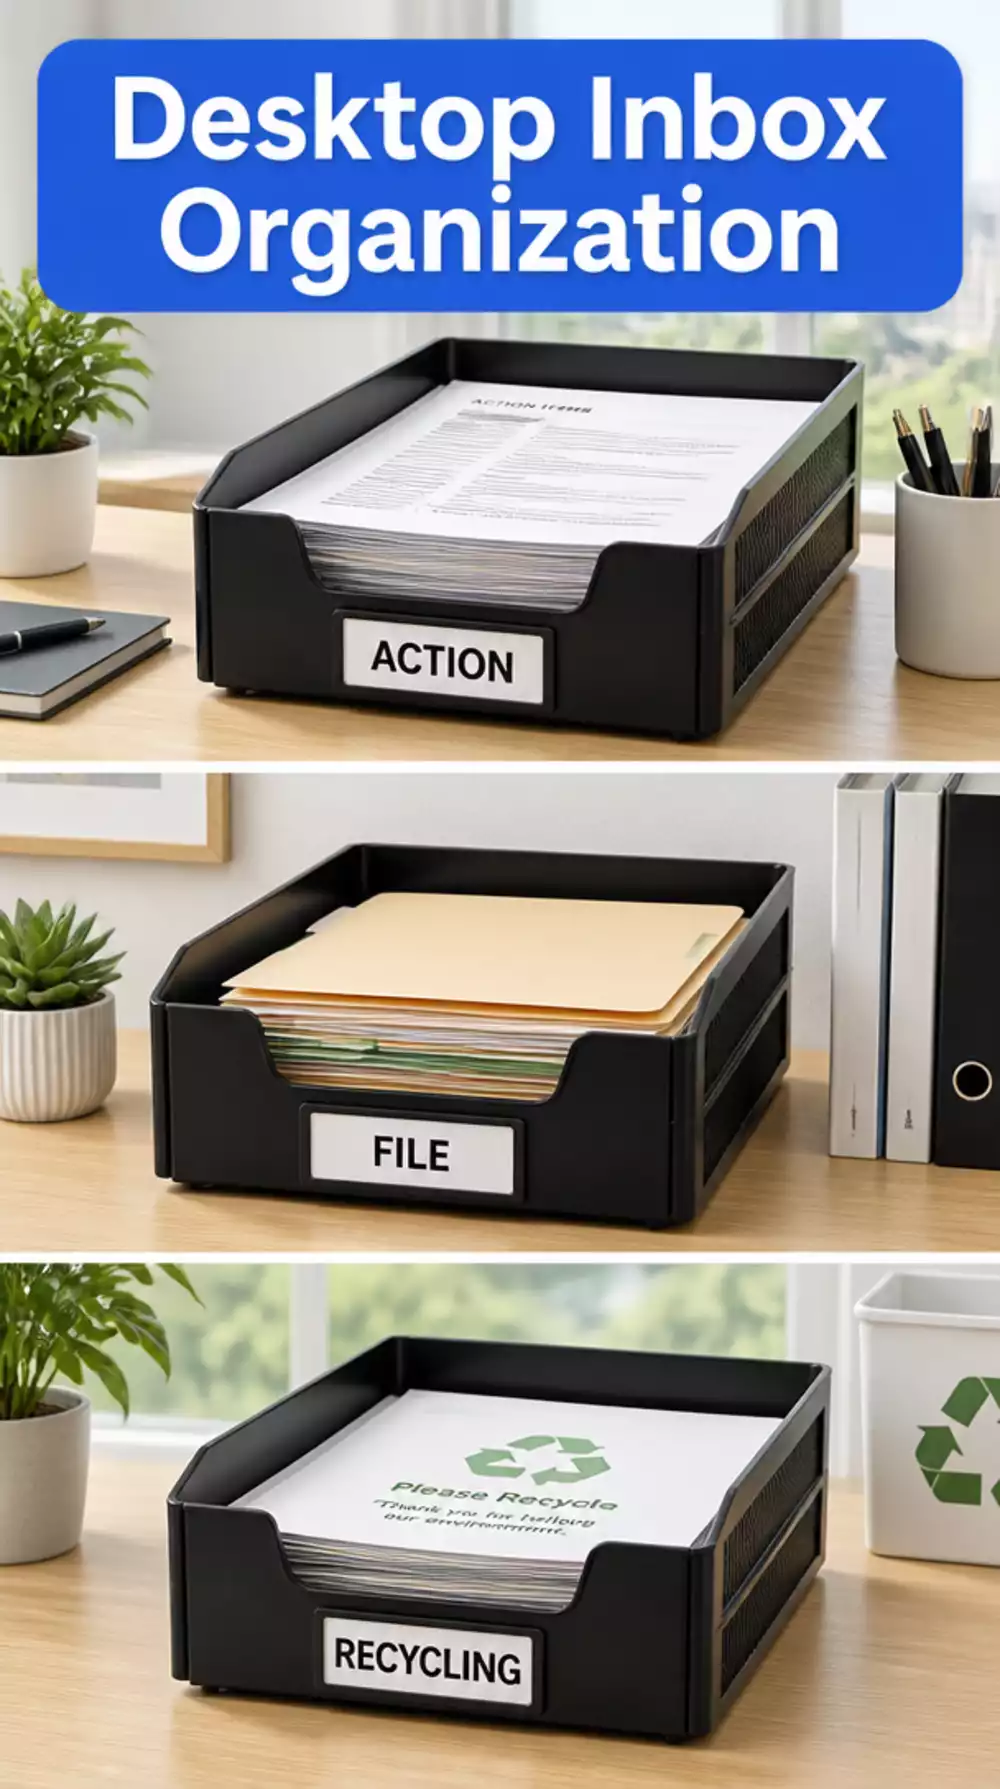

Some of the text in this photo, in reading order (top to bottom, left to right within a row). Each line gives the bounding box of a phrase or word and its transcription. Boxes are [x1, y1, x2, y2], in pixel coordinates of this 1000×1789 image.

[371, 641, 514, 684] ACTION
[374, 1136, 450, 1172] FILE
[391, 1481, 489, 1501] Please
[335, 1637, 521, 1686] RECYCLING
